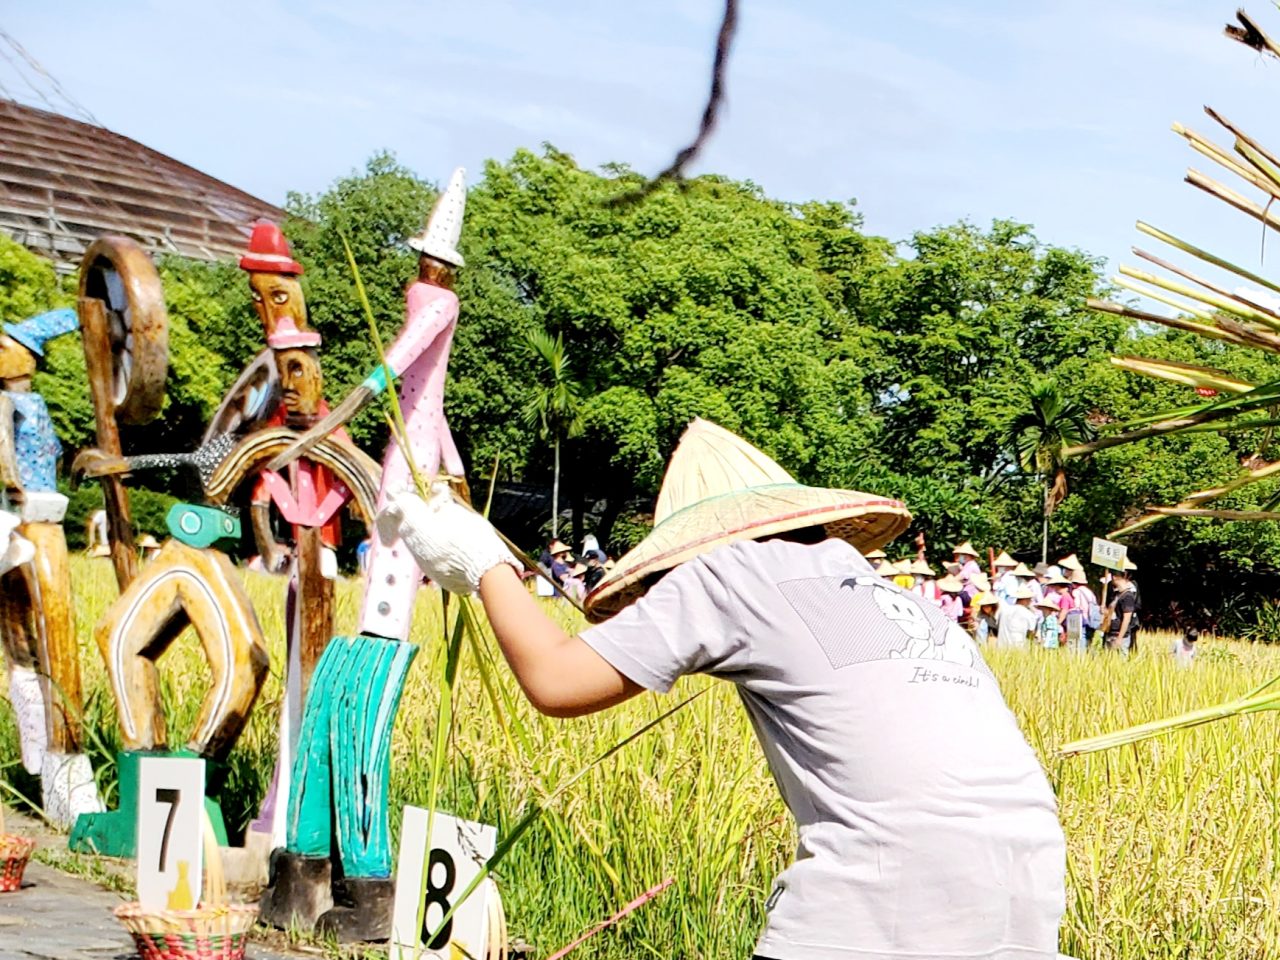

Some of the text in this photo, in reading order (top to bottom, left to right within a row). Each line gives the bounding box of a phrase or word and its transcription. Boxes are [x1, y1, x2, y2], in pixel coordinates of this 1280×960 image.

[907, 666, 939, 684] It's
[155, 788, 181, 873] 7
[420, 847, 457, 951] 8
